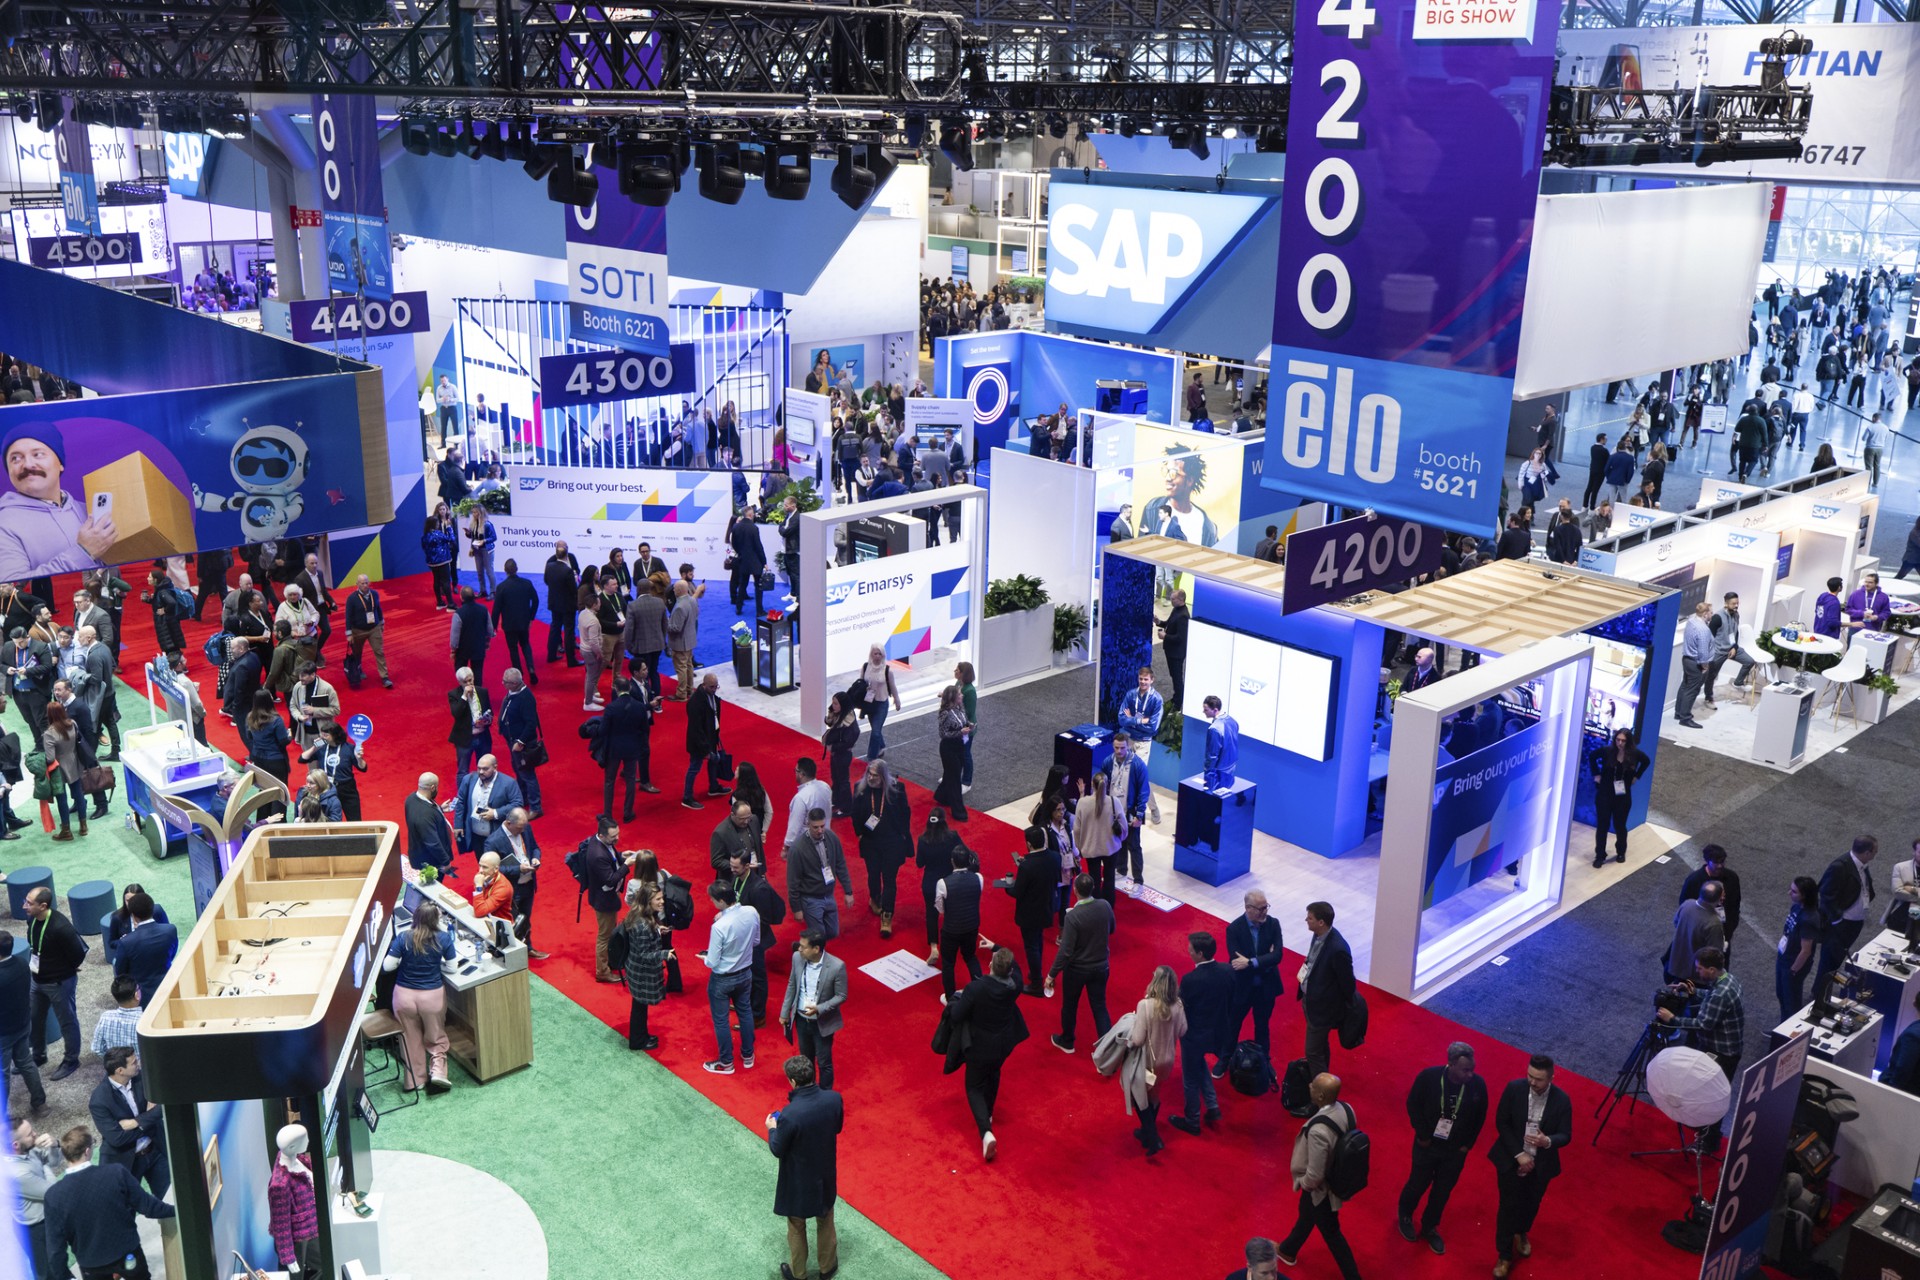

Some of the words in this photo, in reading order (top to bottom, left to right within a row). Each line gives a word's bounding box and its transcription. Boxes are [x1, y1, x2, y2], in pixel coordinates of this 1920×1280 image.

[1426, 10, 1455, 24] BIG
[1460, 9, 1516, 24] SHOW
[1743, 50, 1882, 77] FTIAN
[19, 143, 58, 160] NC
[164, 133, 202, 181] SAP
[1788, 144, 1866, 165] 6747
[46, 239, 126, 263] 4500
[1048, 203, 1204, 305] SAP
[579, 263, 654, 304] SOTI
[311, 299, 411, 333] 4400
[583, 310, 622, 334] Booth
[624, 318, 655, 340] 6221
[328, 343, 361, 354] reailers
[377, 341, 394, 351] SAP
[565, 356, 673, 396] 4300
[1282, 359, 1402, 484] ēlo
[1419, 443, 1482, 475] booth
[520, 478, 539, 489] SAP
[547, 480, 575, 493] Bring
[576, 482, 594, 491] out
[595, 484, 618, 494] your
[620, 482, 647, 494] best.
[1413, 467, 1478, 499] #5621
[1717, 489, 1738, 500] SAP
[1629, 513, 1650, 526] SAP
[1812, 505, 1834, 519] SAP
[502, 526, 529, 536] Thank
[531, 528, 551, 538] you
[552, 529, 561, 538] to
[1728, 533, 1750, 548] SAP
[502, 540, 519, 548] our
[1657, 540, 1673, 555] aws
[1310, 521, 1423, 590] 4200
[1582, 552, 1597, 562] SAP
[826, 585, 851, 602] SAP
[858, 573, 914, 596] Emarsys
[861, 604, 896, 619] Omnichannel
[852, 617, 886, 631] Engagement
[1240, 679, 1262, 693] SAP
[1453, 769, 1486, 797] Bring
[1485, 761, 1503, 781] out
[1503, 753, 1528, 778] your
[1433, 785, 1445, 806] AP
[155, 797, 182, 824] Welcome
[1718, 1065, 1768, 1234] 4200
[1900, 1197, 1920, 1211] TRA
